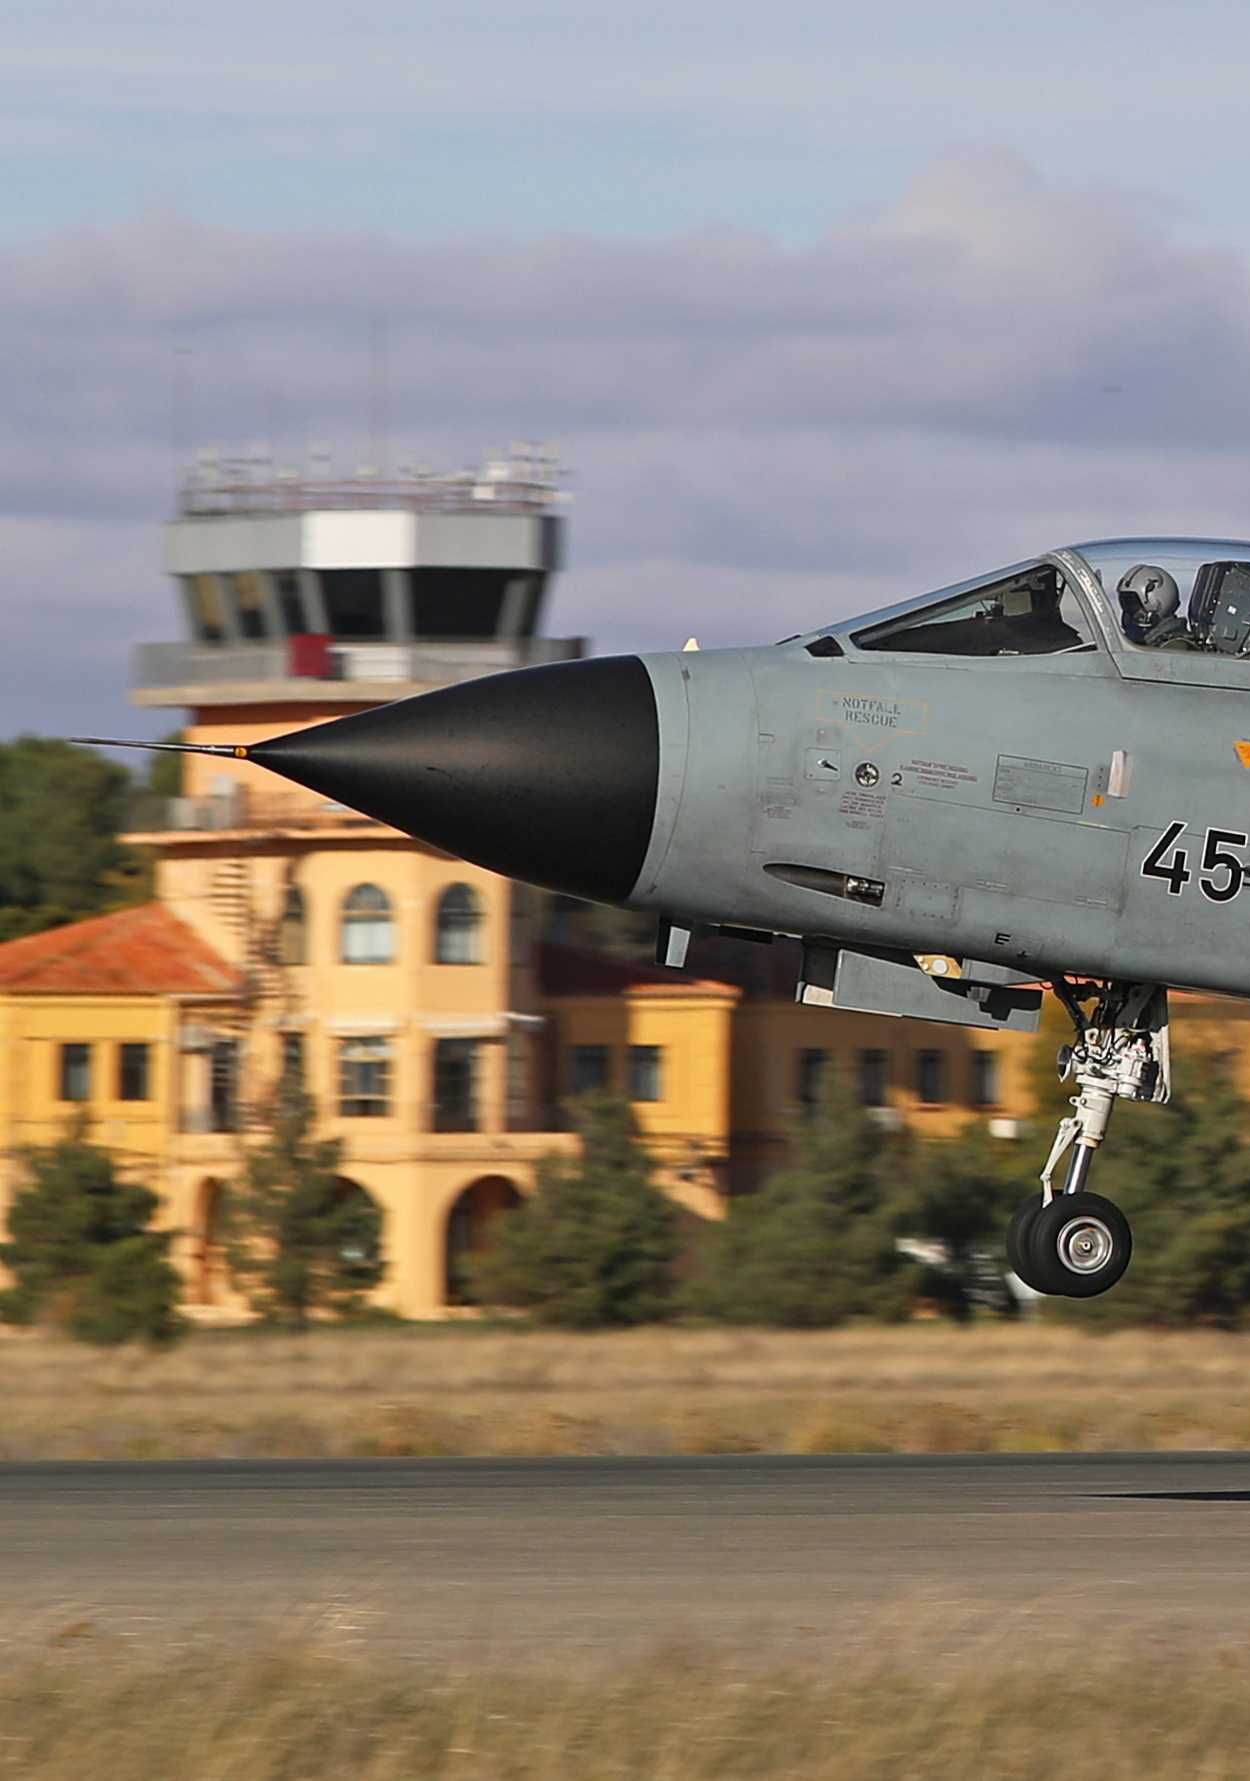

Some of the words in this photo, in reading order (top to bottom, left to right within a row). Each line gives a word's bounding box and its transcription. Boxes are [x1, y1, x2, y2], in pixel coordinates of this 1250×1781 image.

[842, 697, 901, 715] NOTFALL
[845, 710, 897, 728] RESCUE
[891, 772, 902, 786] 2
[1141, 821, 1248, 903] 45
[994, 932, 1011, 945] E
